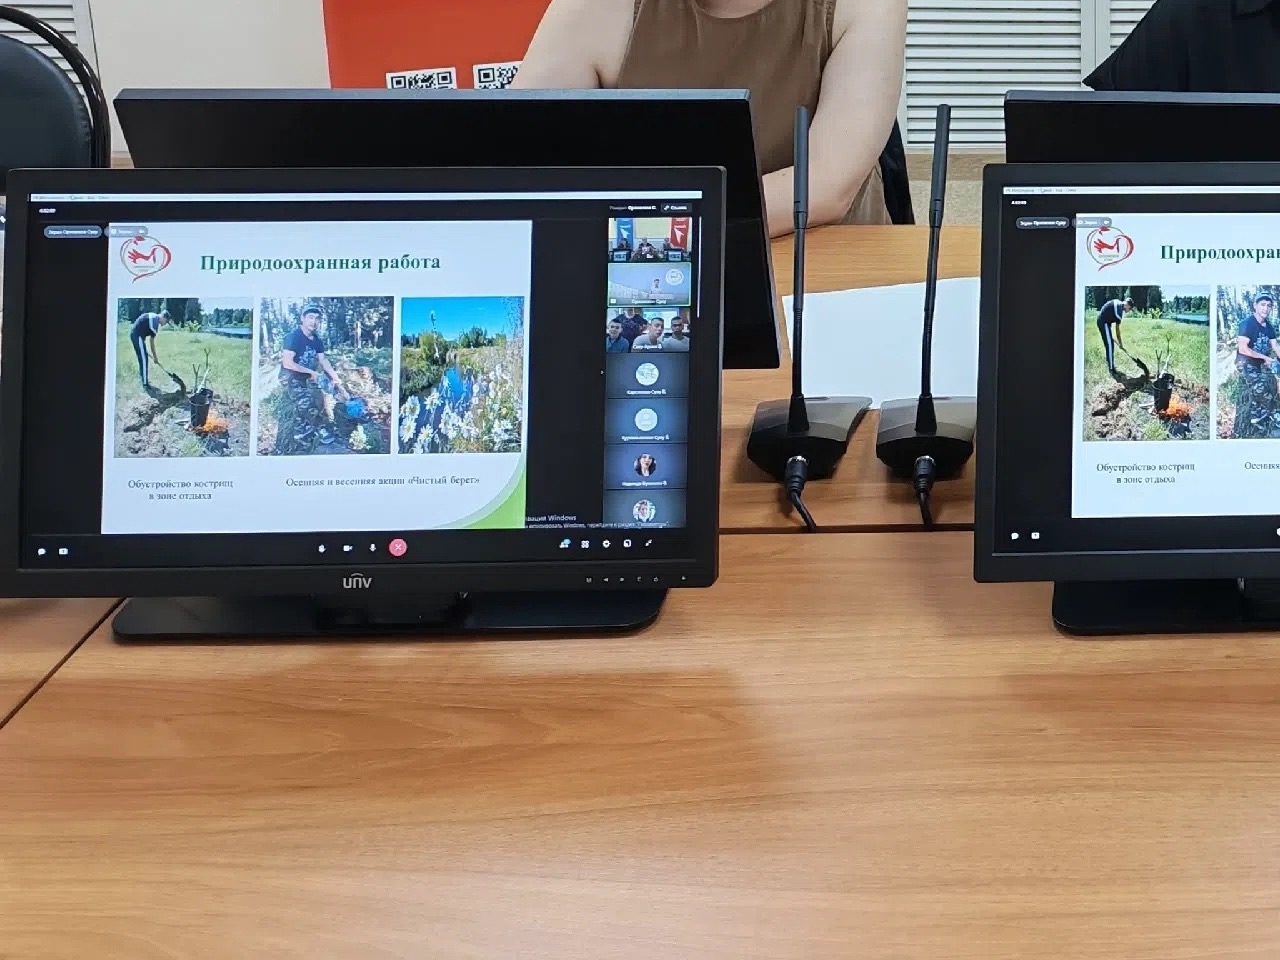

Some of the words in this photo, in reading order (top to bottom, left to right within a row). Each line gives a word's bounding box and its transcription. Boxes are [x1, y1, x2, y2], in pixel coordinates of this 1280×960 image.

[200, 255, 372, 274] Природоохранная
[377, 254, 441, 273] работа
[1096, 463, 1156, 473] Обустройство
[127, 479, 191, 490] Обустройство
[335, 478, 376, 486] весенняя
[378, 478, 404, 486] акции
